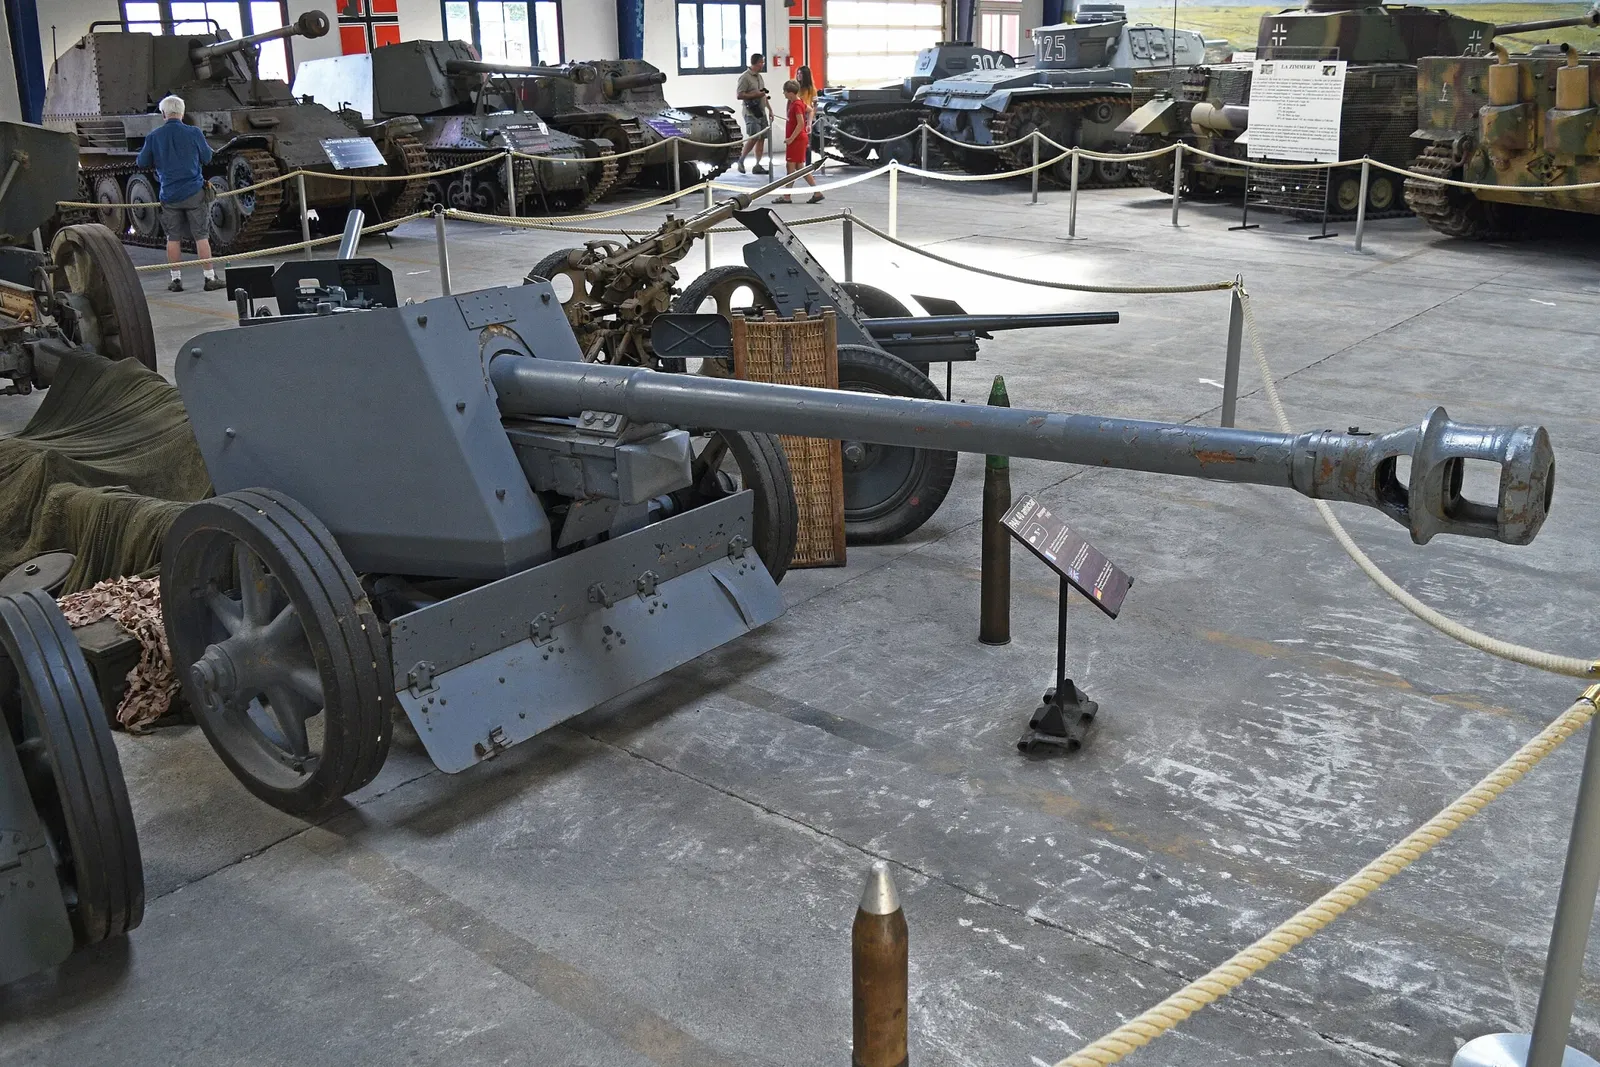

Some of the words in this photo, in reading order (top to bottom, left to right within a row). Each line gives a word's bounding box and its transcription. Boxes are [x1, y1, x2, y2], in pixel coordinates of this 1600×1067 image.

[1037, 35, 1067, 62] 125
[971, 54, 1005, 71] 304
[1008, 516, 1021, 530] PAK
[1015, 511, 1025, 521] 40
